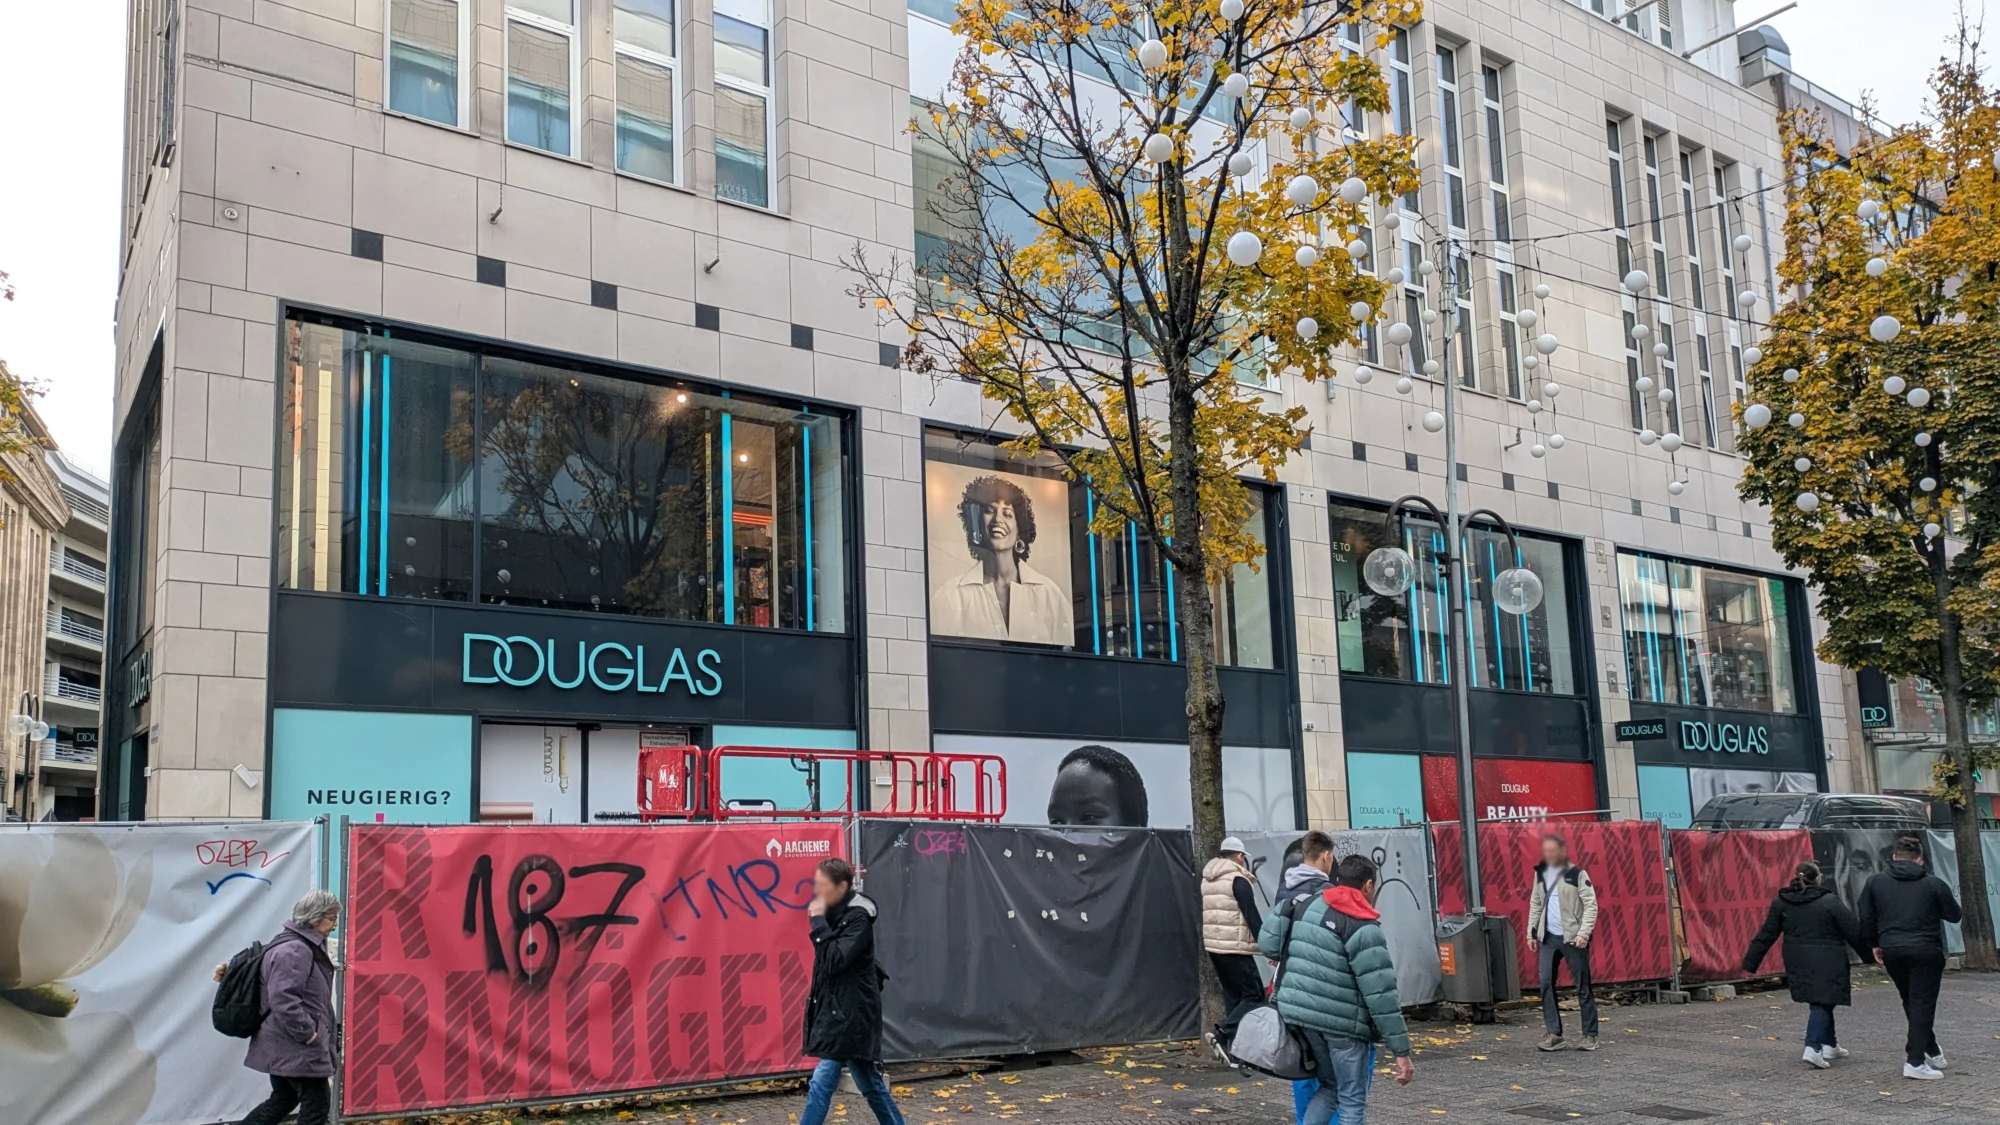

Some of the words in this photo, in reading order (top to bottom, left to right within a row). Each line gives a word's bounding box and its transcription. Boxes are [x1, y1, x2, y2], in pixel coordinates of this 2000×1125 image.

[1340, 542, 1351, 552] TO
[463, 632, 723, 697] DOUGLAS
[1621, 724, 1664, 736] DOUGLAS
[1680, 720, 1769, 754] DOUGLAS
[1502, 784, 1530, 794] DOUGLAS
[307, 789, 451, 805] NEUGIERIG?
[1360, 806, 1385, 815] DOUGLAS
[1392, 805, 1410, 815] KÖLN
[1487, 806, 1549, 823] BEAUTY
[1645, 811, 1663, 819] DOUGLAS
[784, 840, 830, 852] AACHENER
[1437, 824, 1664, 903] AACENE
[462, 854, 646, 986] 187
